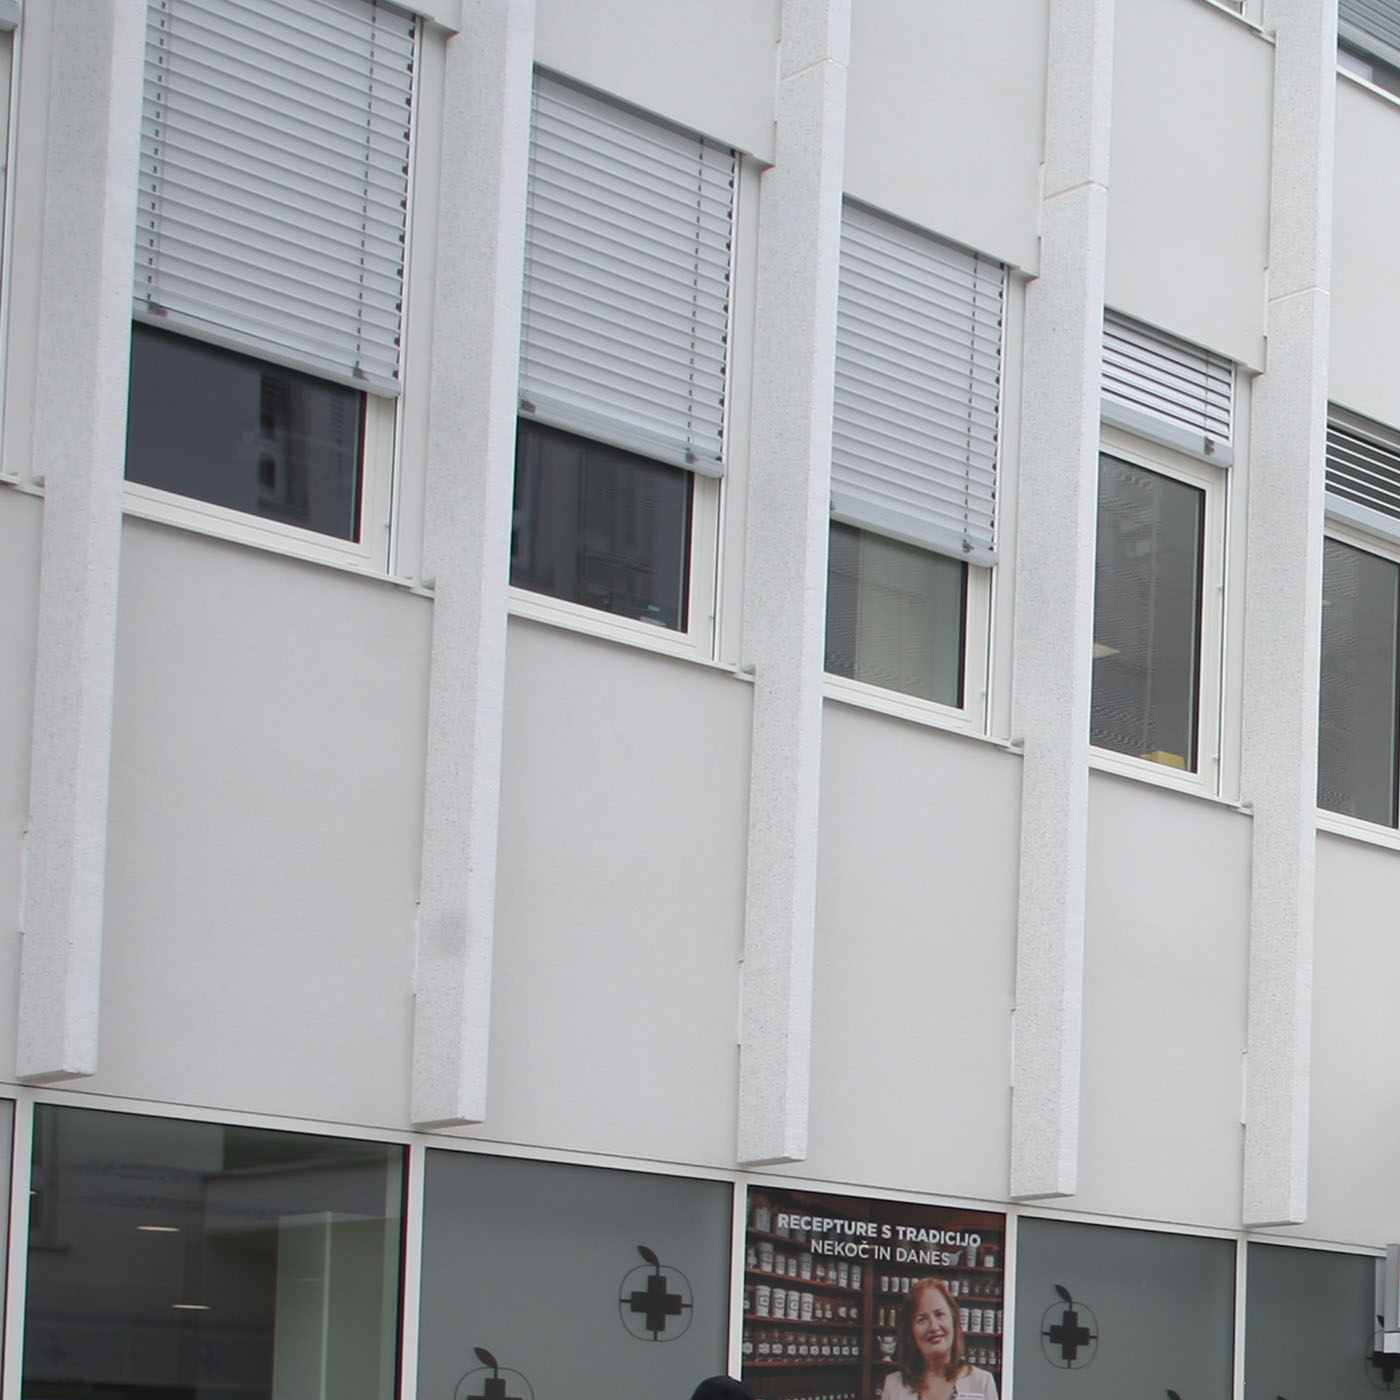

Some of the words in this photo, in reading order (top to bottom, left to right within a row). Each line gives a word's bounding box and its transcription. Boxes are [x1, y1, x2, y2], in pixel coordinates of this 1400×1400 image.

[777, 1212, 878, 1238] RECEPTURE
[881, 1224, 892, 1239] S
[896, 1226, 982, 1248] TRADICIJO
[811, 1239, 870, 1259] NEKOČ
[874, 1245, 891, 1262] IN
[896, 1247, 951, 1266] DANES
